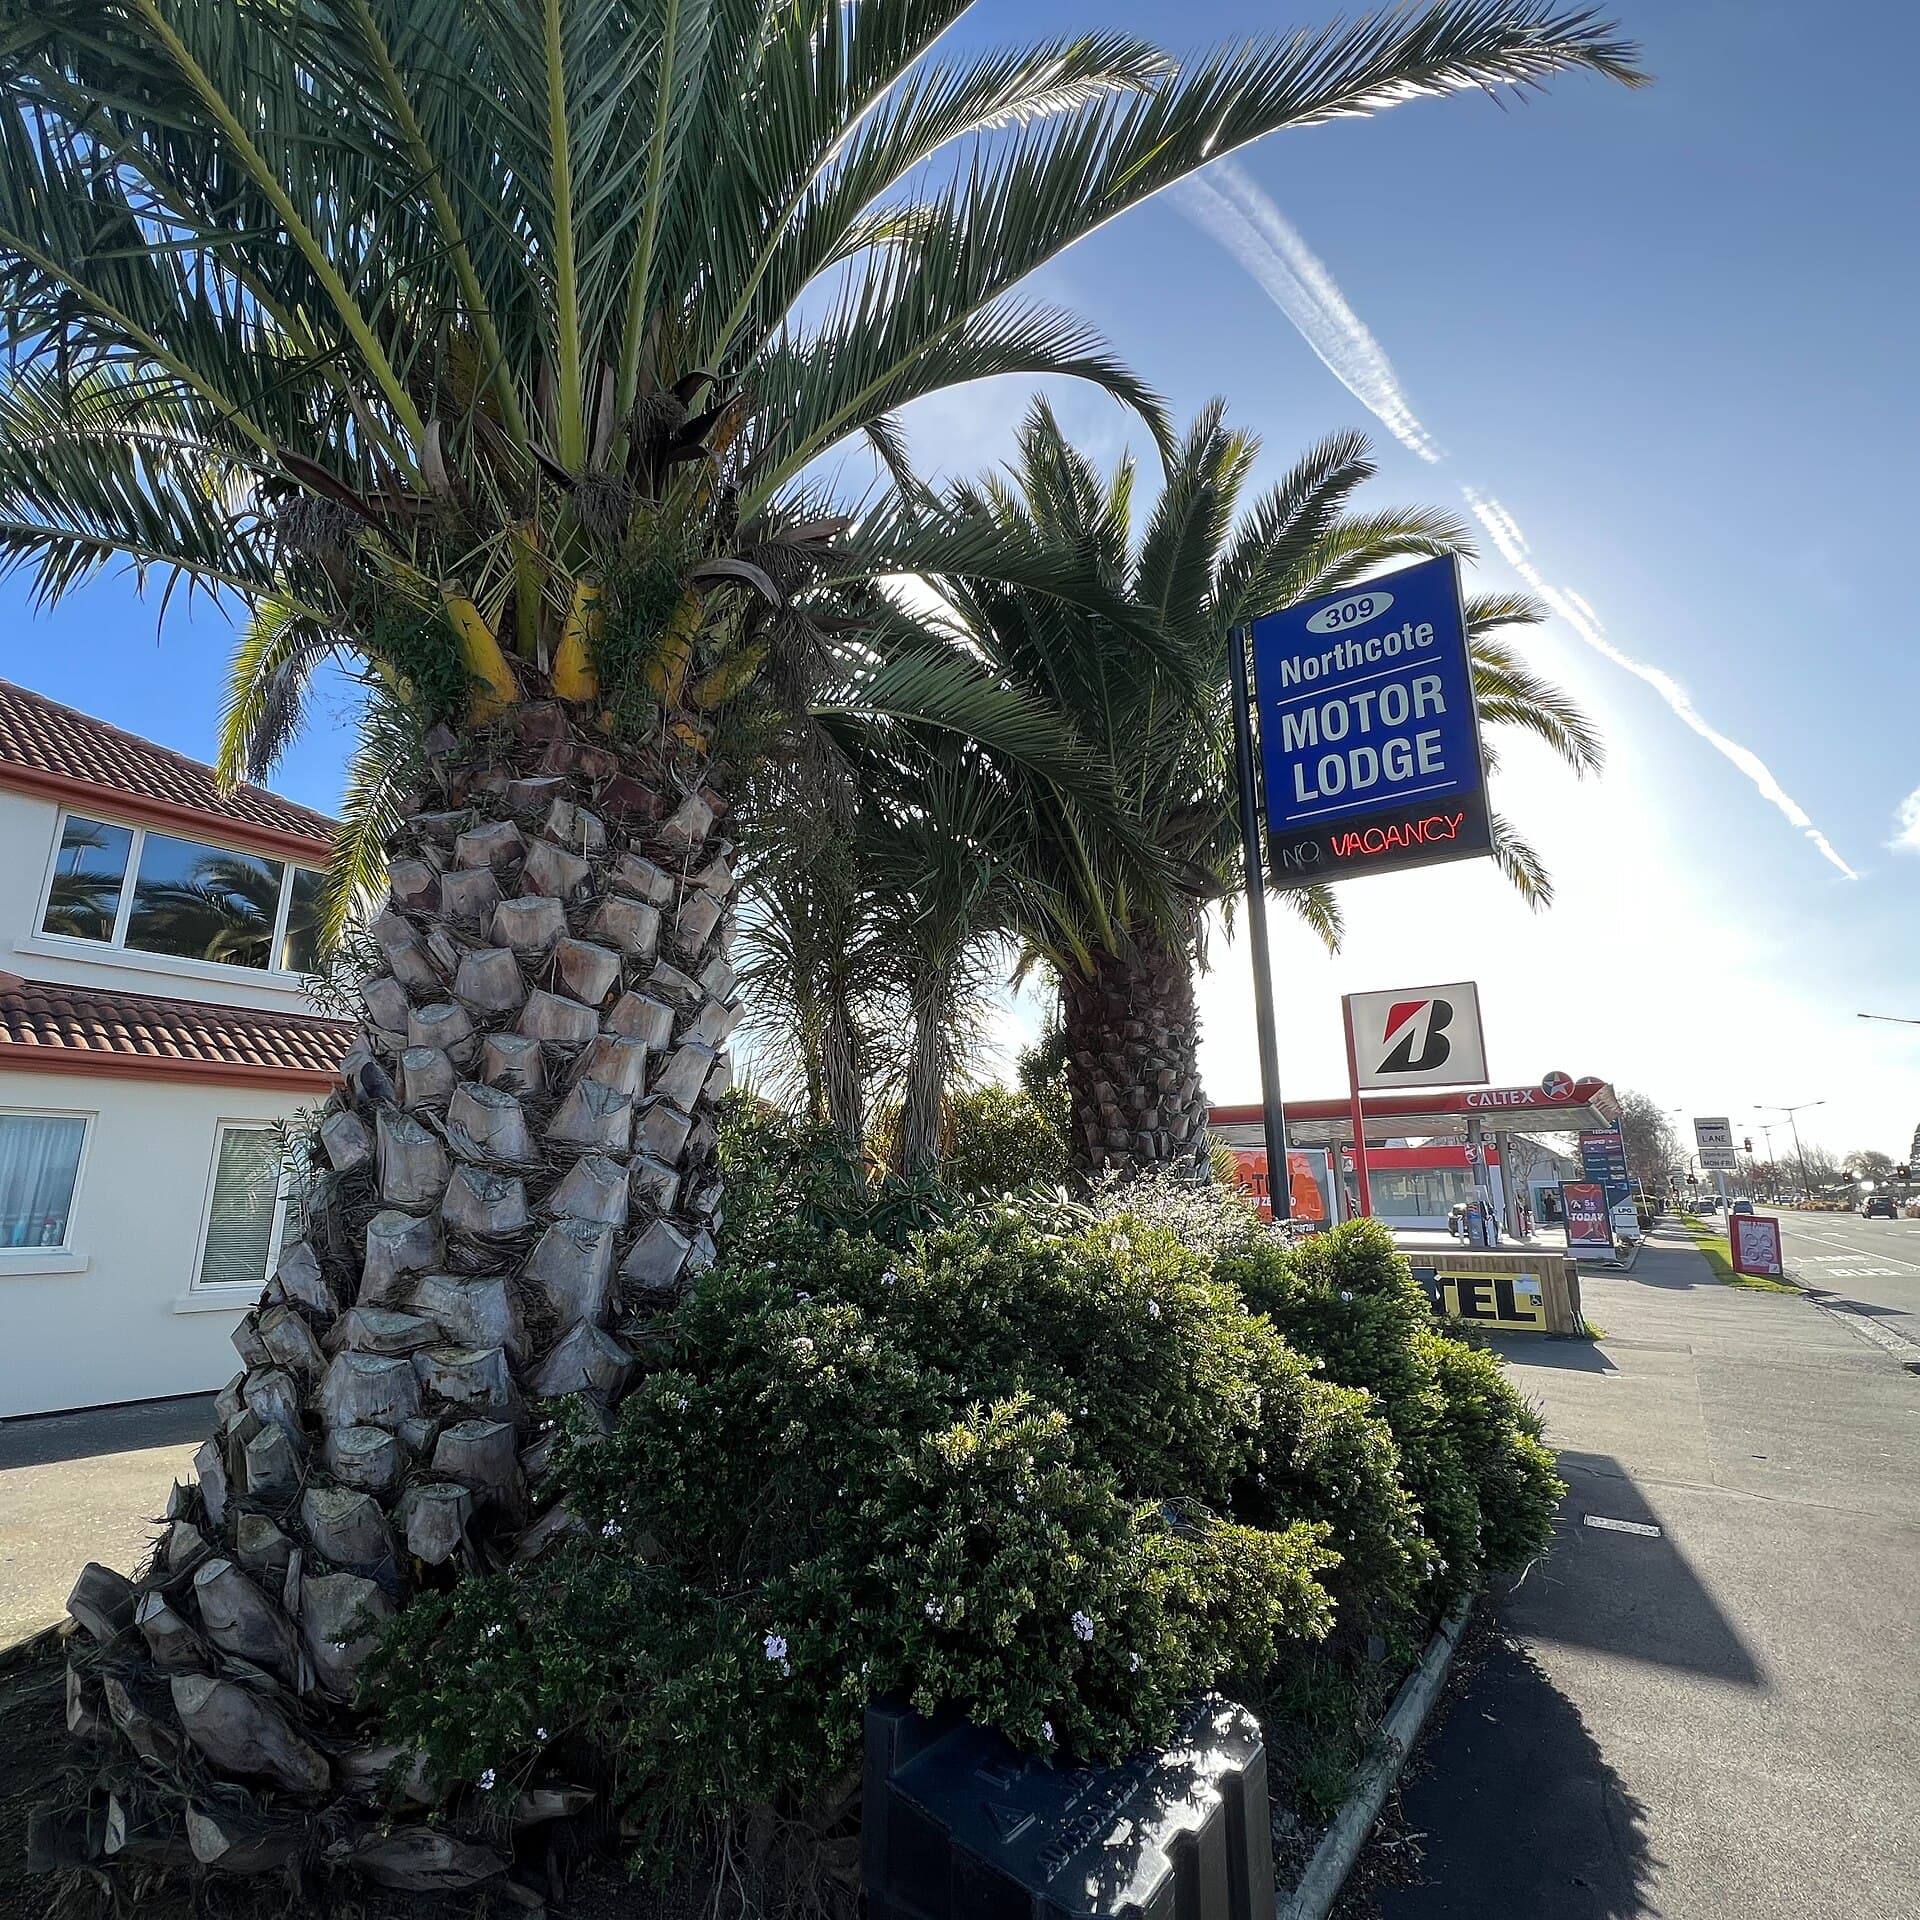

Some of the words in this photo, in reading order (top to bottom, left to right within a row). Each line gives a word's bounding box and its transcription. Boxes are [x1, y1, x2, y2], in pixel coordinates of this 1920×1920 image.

[1324, 597, 1375, 630] 309
[1280, 621, 1435, 688] Northcote
[1281, 674, 1447, 753] MOTOR
[1293, 729, 1446, 803] LODGE
[1282, 841, 1321, 868] NO
[1331, 811, 1464, 857] VACANCY
[1466, 1089, 1536, 1107] CALTEX
[1701, 1134, 1728, 1143] LANE
[1570, 1212, 1604, 1222] TODAY
[1826, 1267, 1905, 1277] BUS
